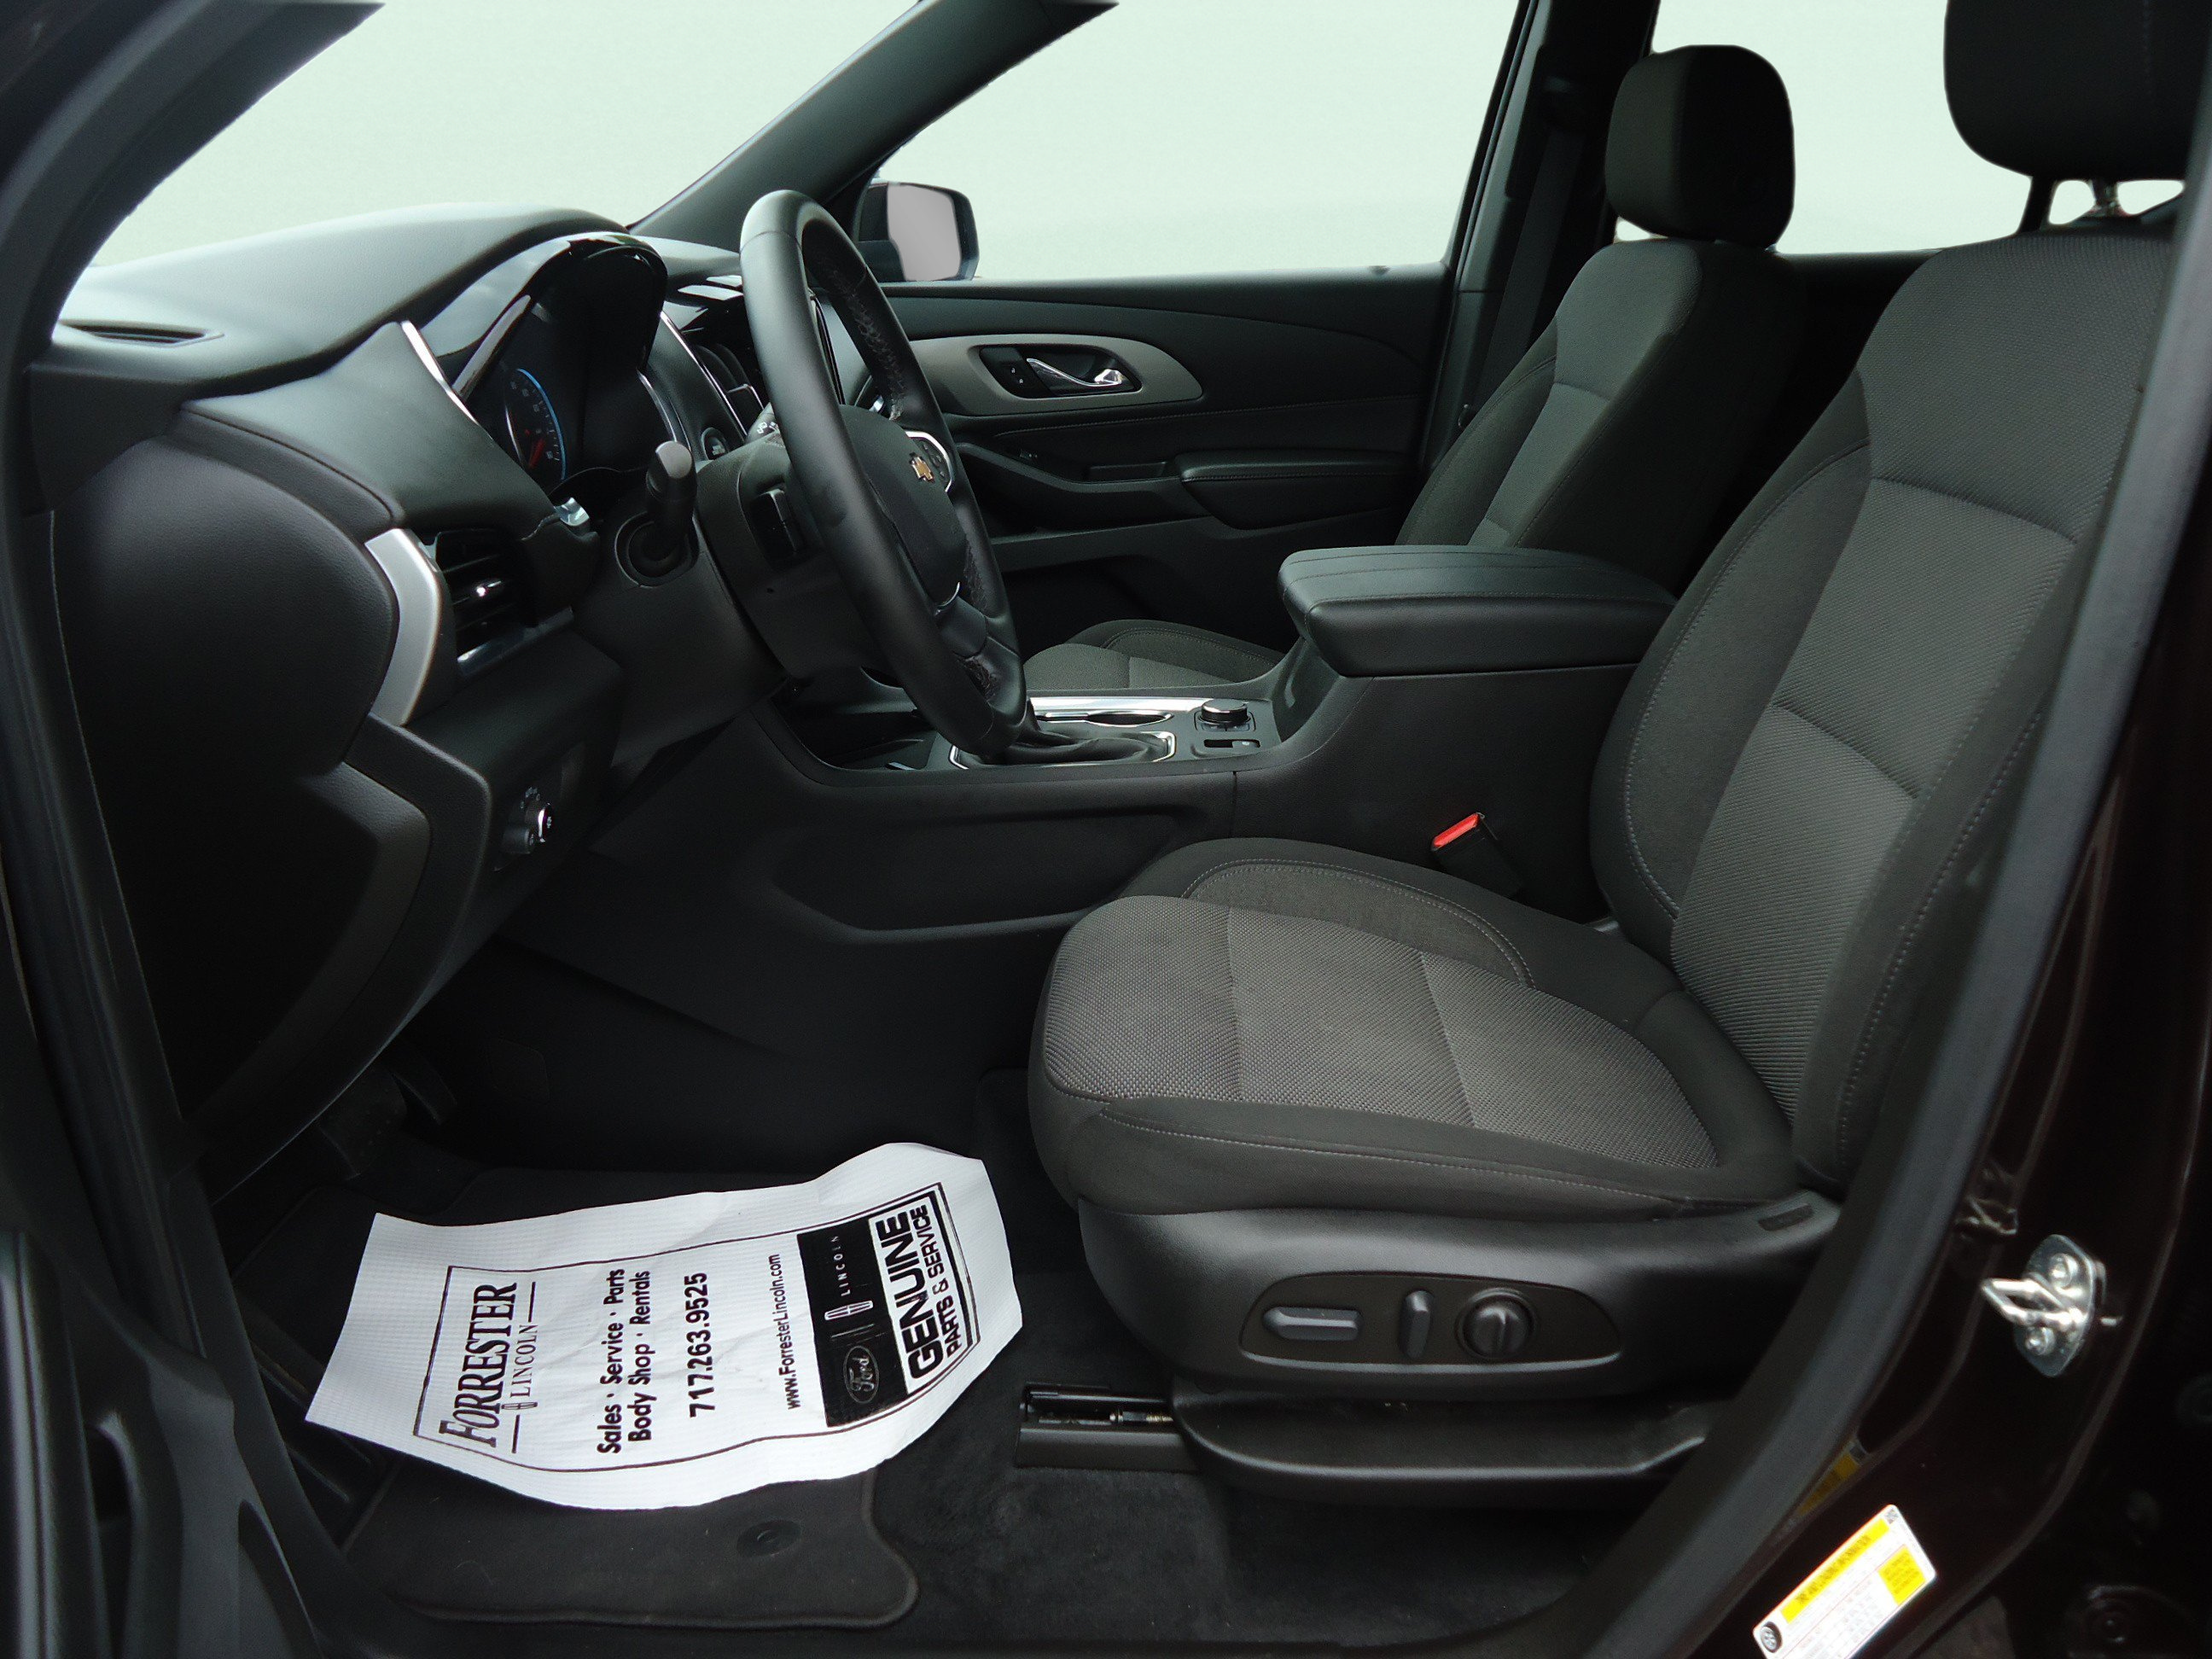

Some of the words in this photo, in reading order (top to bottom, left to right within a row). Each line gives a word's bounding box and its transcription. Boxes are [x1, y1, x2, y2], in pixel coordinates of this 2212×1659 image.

[910, 1204, 945, 1278] SERVICE
[603, 1268, 626, 1305] Parts
[629, 1270, 651, 1326] Rentals
[876, 1211, 944, 1380] GENUINE
[933, 1277, 950, 1295] &
[600, 1322, 624, 1385] Service
[684, 1272, 716, 1418] 717.263.9525
[768, 1253, 801, 1412] www.ForresterLincoln.com
[936, 1295, 963, 1359] PARTS
[438, 1282, 518, 1447] FORRESTER
[511, 1324, 539, 1398] LINCOLN
[628, 1344, 655, 1386] Shop
[848, 1353, 876, 1394] Ford
[597, 1404, 623, 1453] Sales
[627, 1392, 657, 1442] Body
